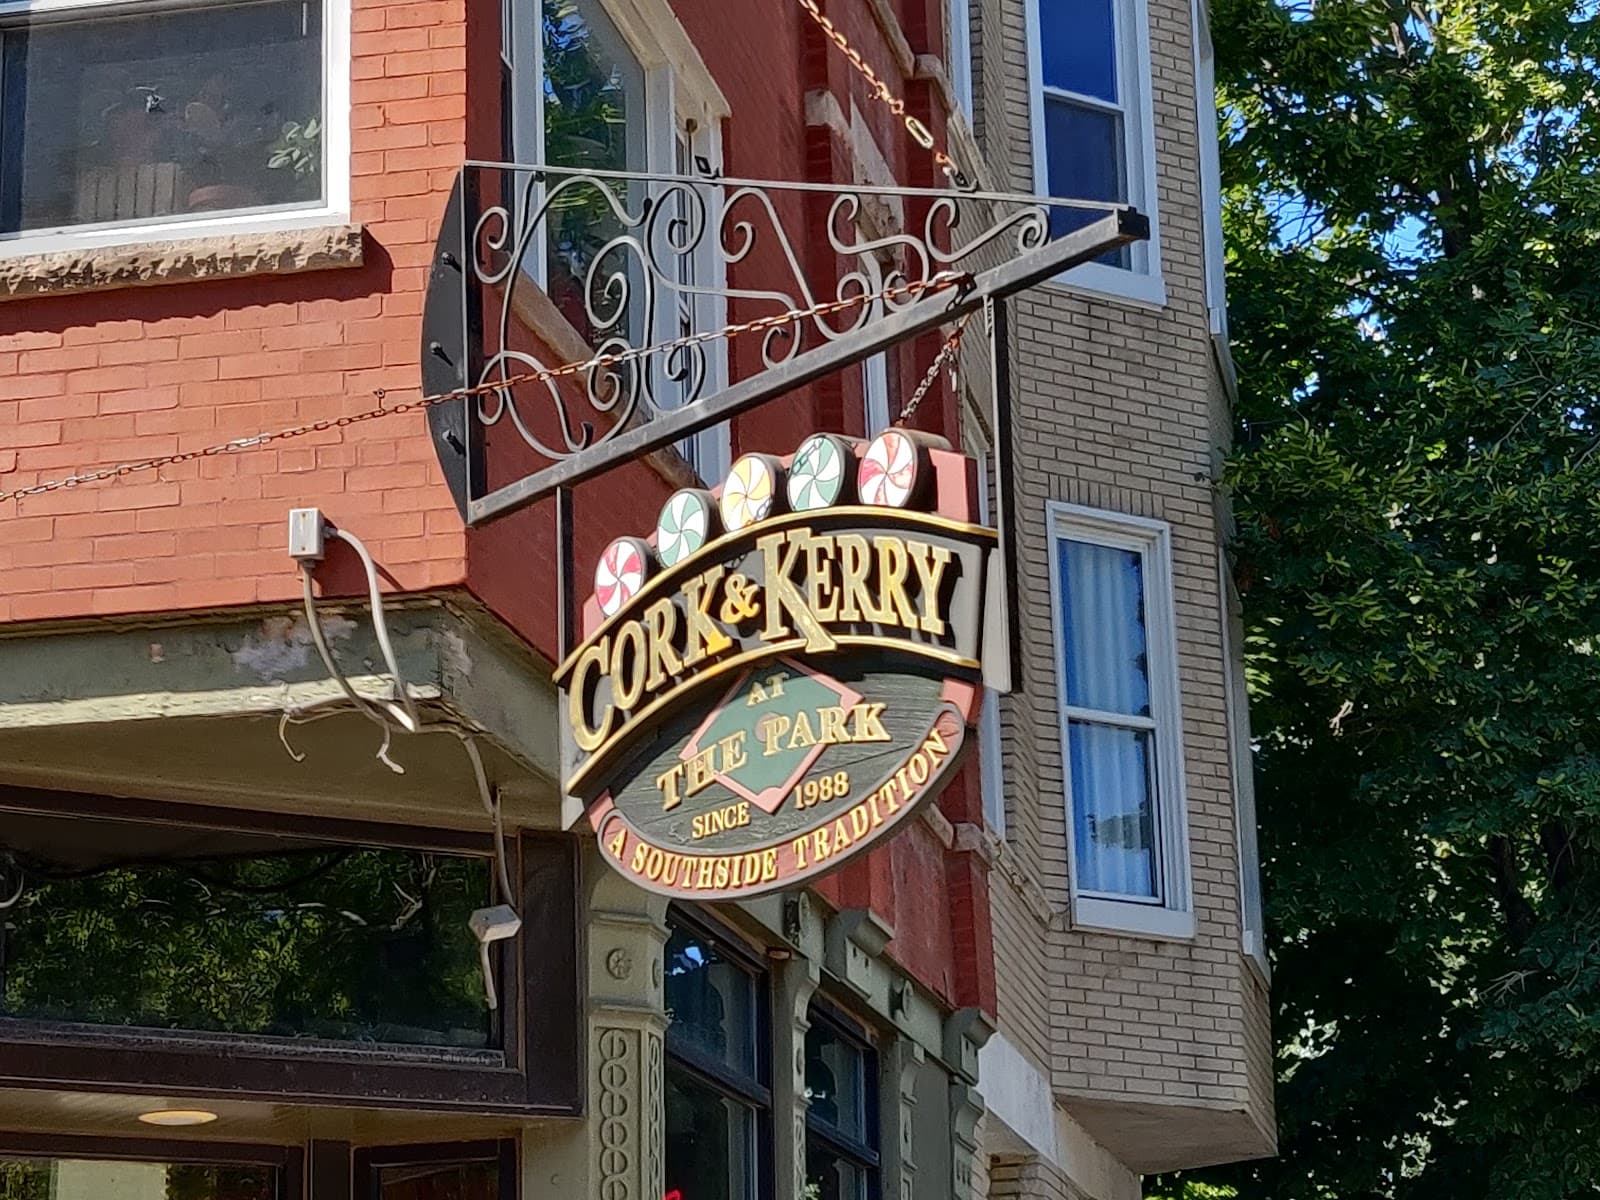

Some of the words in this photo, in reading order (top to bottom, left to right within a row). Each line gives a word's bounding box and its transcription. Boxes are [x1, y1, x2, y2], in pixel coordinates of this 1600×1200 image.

[569, 565, 732, 750] CORK
[720, 572, 760, 625] &
[757, 527, 951, 652] KERRY
[746, 671, 790, 707] AT
[608, 829, 626, 862] A
[632, 844, 778, 889] SOUTHSIDE
[794, 729, 950, 870] TRADITION
[657, 731, 747, 810] THE
[763, 703, 890, 756] PARK
[692, 803, 750, 840] SINCE
[793, 771, 851, 810] 1988
